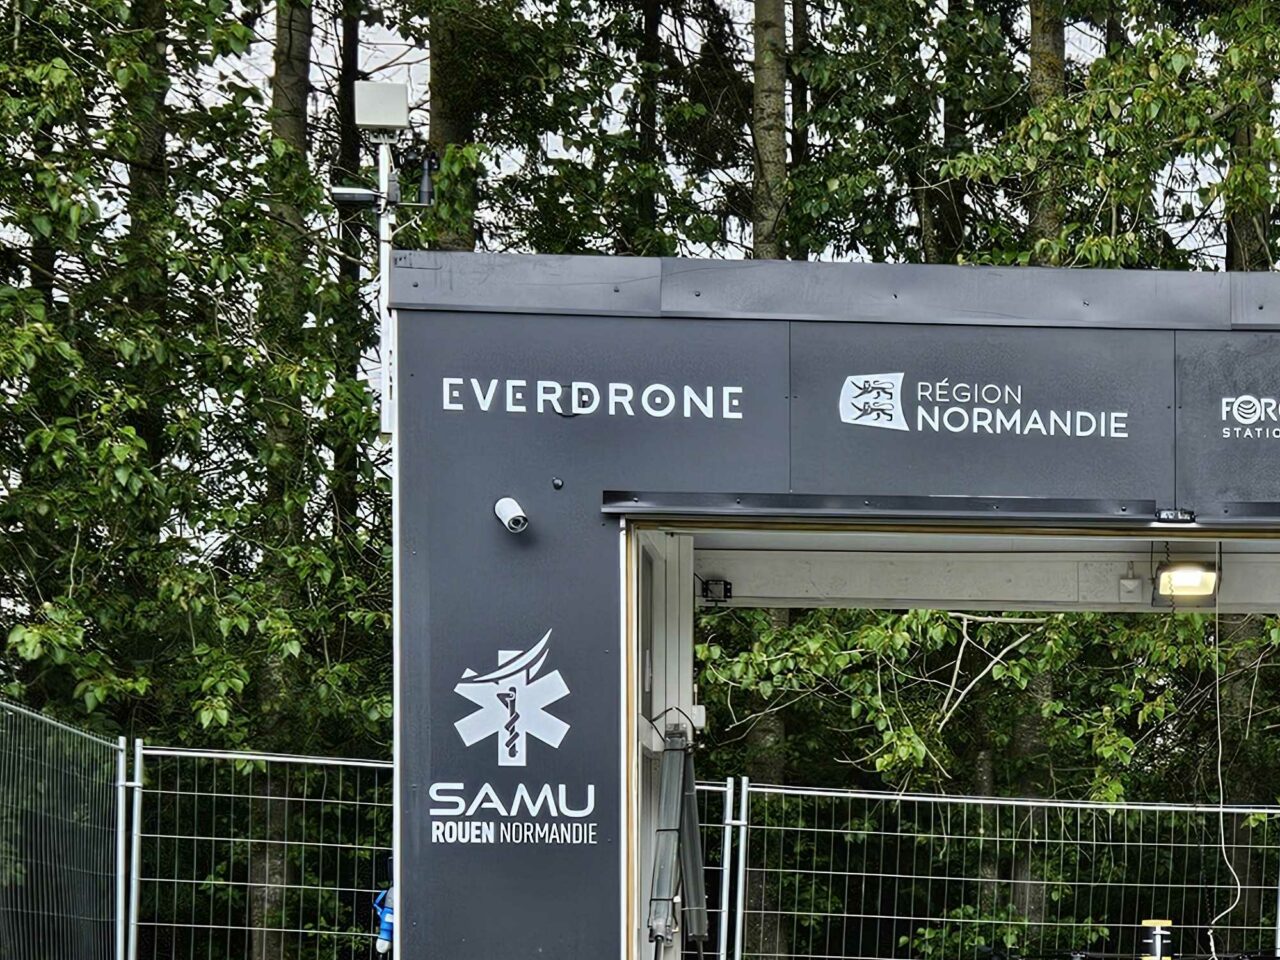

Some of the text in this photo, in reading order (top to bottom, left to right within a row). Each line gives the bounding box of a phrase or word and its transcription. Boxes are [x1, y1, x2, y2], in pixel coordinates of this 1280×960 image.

[442, 377, 744, 419] EVERDRONE
[917, 377, 1023, 404] RÉGION
[917, 404, 1129, 438] NORMANDIE
[428, 781, 596, 818] SAMU
[431, 820, 598, 845] ROUEN NORMANDIE
